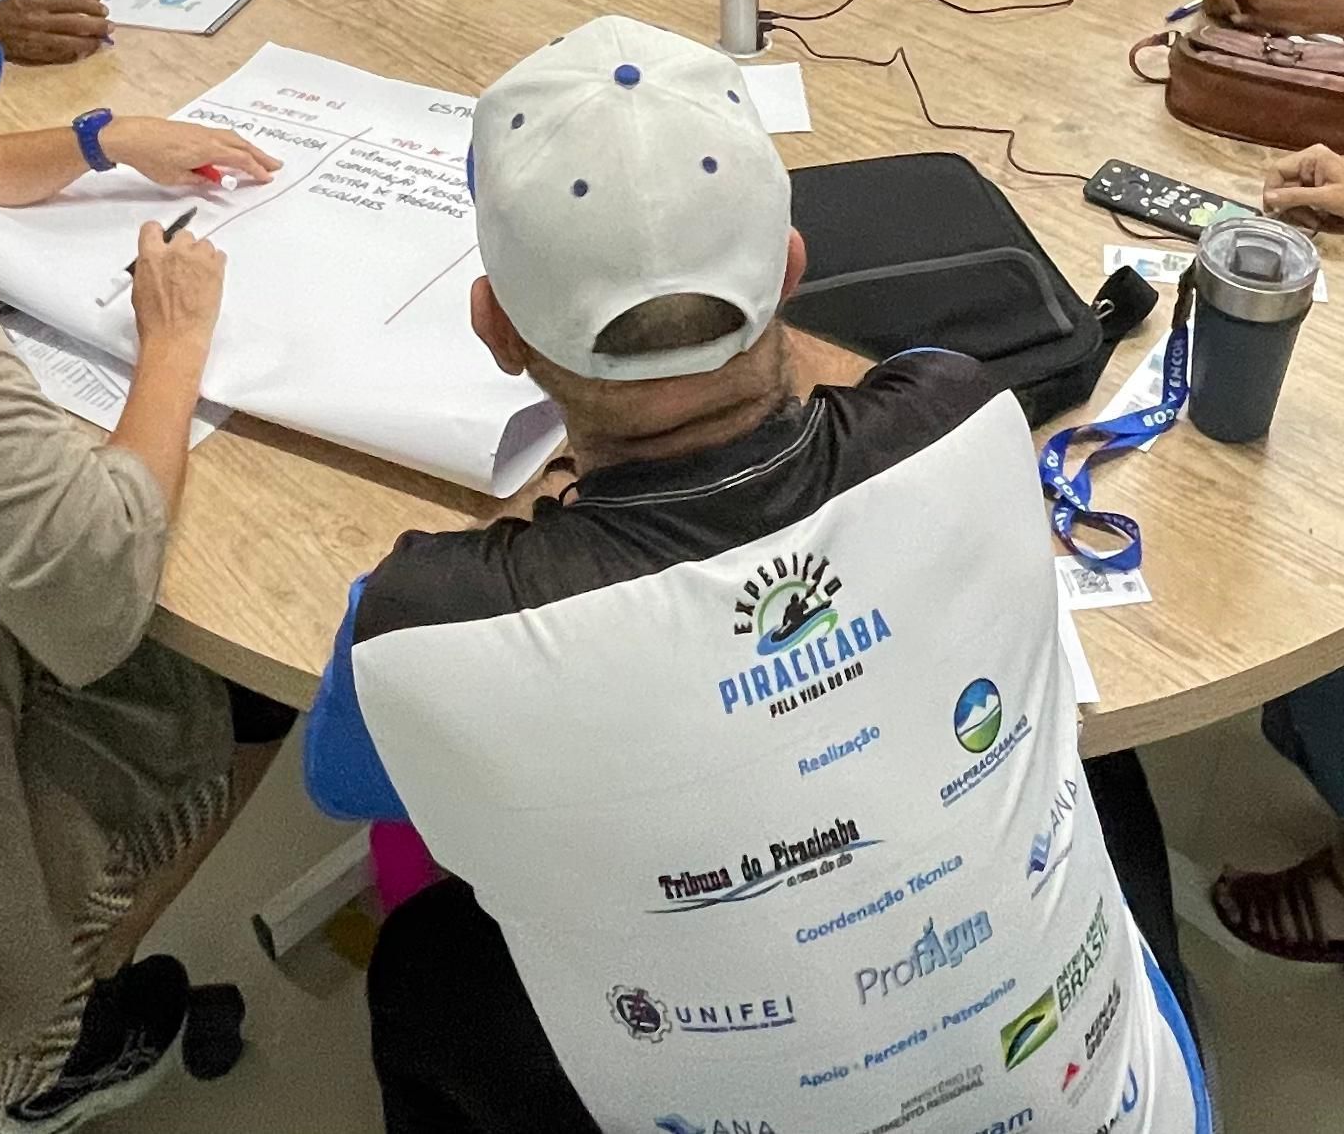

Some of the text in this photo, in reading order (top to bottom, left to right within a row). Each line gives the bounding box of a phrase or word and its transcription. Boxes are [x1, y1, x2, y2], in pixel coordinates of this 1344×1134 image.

[719, 608, 892, 714] PIRACICABA
[769, 696, 799, 718] PELA
[828, 671, 844, 691] DO
[844, 661, 864, 683] RIO
[797, 725, 881, 777] Realização
[658, 867, 733, 899] Tribuna
[769, 818, 860, 872] Piracicaba
[796, 888, 905, 945] Coordenação
[907, 854, 964, 896] Técnica
[855, 909, 994, 1006] ProfÁgua
[1057, 915, 1110, 1013] BRASIL
[674, 993, 794, 1025] UNIFEI
[798, 977, 1017, 1089] Apoio Parceria Patrocínio
